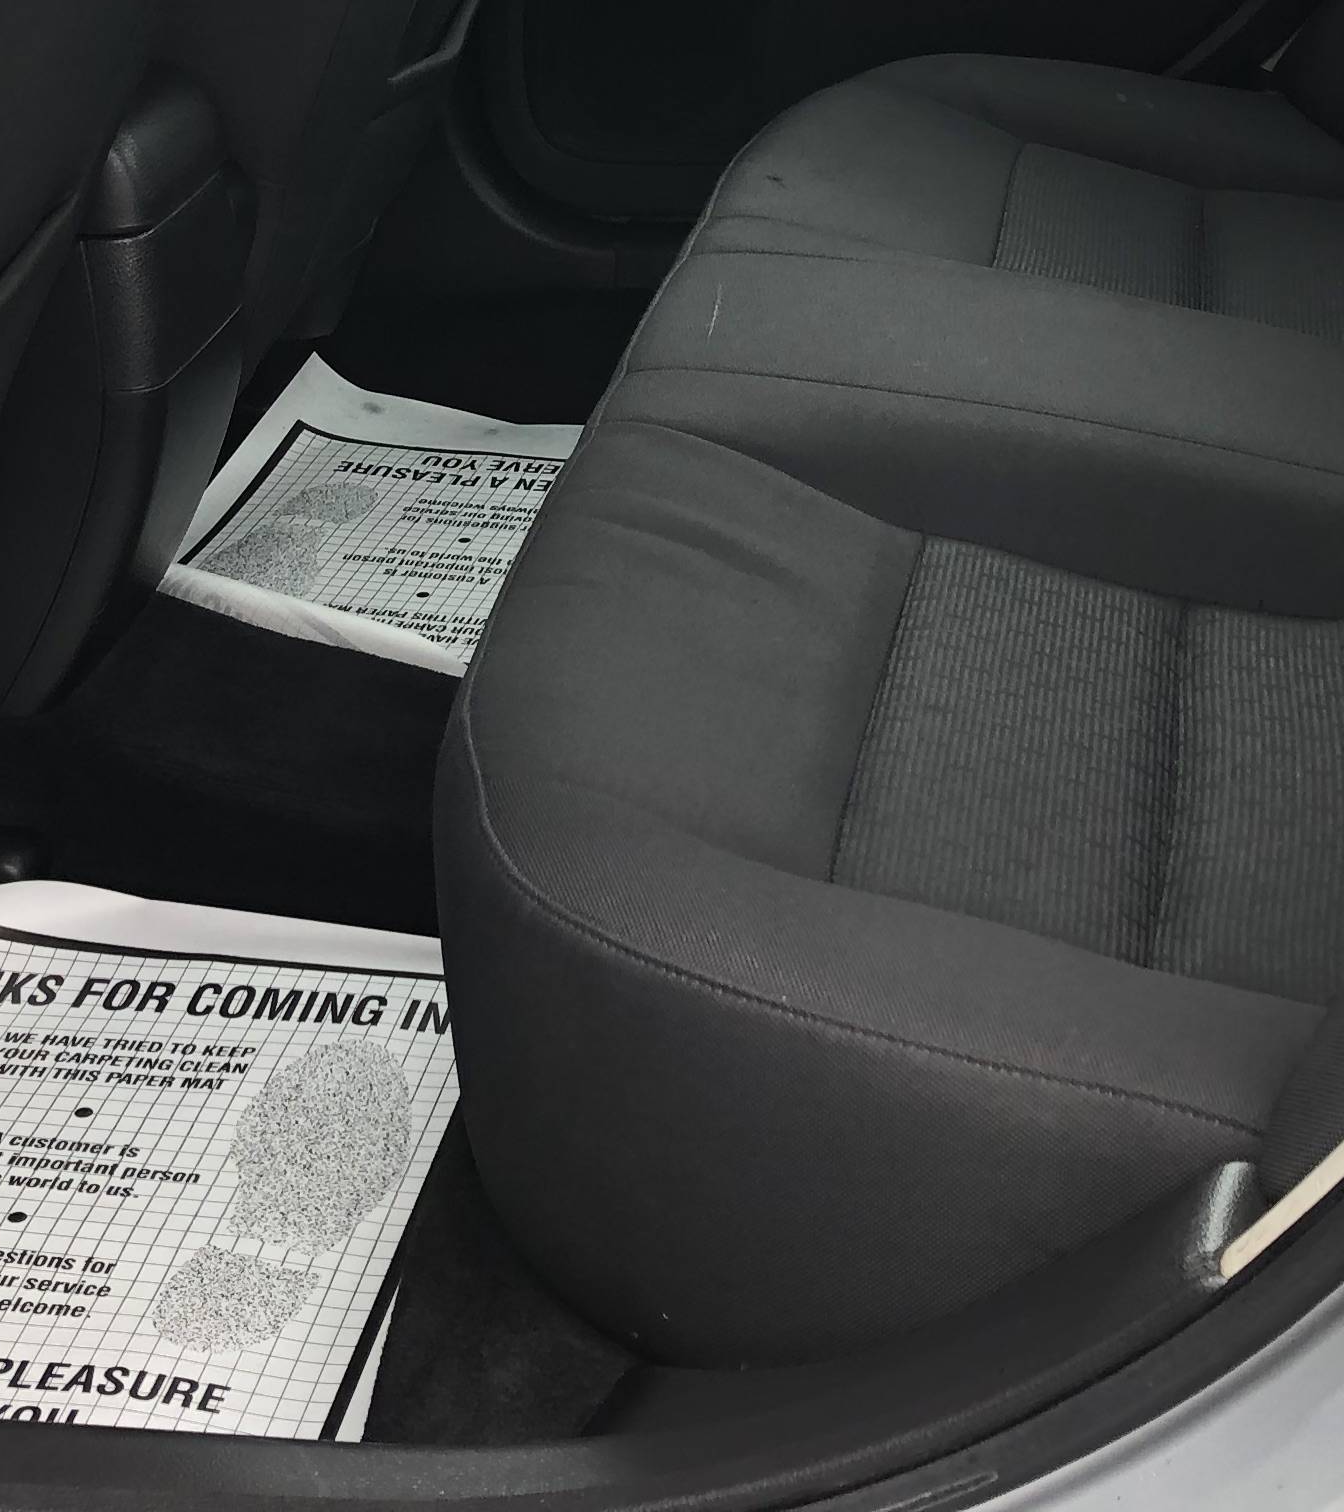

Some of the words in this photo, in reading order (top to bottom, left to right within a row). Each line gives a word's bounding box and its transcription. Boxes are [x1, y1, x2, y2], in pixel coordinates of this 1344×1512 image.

[421, 455, 477, 470] YOU
[487, 460, 561, 474] ERVE
[333, 461, 481, 486] PLEASURE
[490, 476, 509, 488] A
[512, 478, 554, 491] EN
[403, 507, 458, 516] service
[461, 511, 486, 520] our
[400, 515, 421, 523] for
[426, 518, 517, 531] suggestions
[342, 552, 397, 564] person
[410, 550, 426, 559] to
[428, 552, 473, 562] world
[478, 556, 503, 566] the
[383, 568, 398, 576] is
[398, 559, 474, 572] important
[401, 571, 475, 583] customer
[355, 607, 408, 618] PAPER
[411, 612, 448, 623] THIS
[71, 977, 176, 1013] FOR
[186, 983, 388, 1026] COMING
[400, 999, 452, 1035] IN
[4, 1032, 38, 1044] WE
[41, 1034, 97, 1048] HAVE
[103, 1038, 163, 1053] TRIED
[170, 1043, 197, 1055] TO
[202, 1045, 256, 1058] KEEP
[54, 1051, 174, 1070] CARPETING
[179, 1060, 249, 1074] CLEAN
[53, 1067, 101, 1082] THIS
[105, 1072, 176, 1087] PAPER
[180, 1077, 228, 1090] MAT
[9, 1135, 115, 1155] customer
[119, 1144, 140, 1158] is
[8, 1153, 117, 1176] important
[120, 1166, 201, 1184] person
[8, 1172, 73, 1192] world
[77, 1180, 100, 1194] to
[105, 1184, 140, 1199] us.
[81, 1255, 117, 1275] for
[24, 1276, 111, 1298] service
